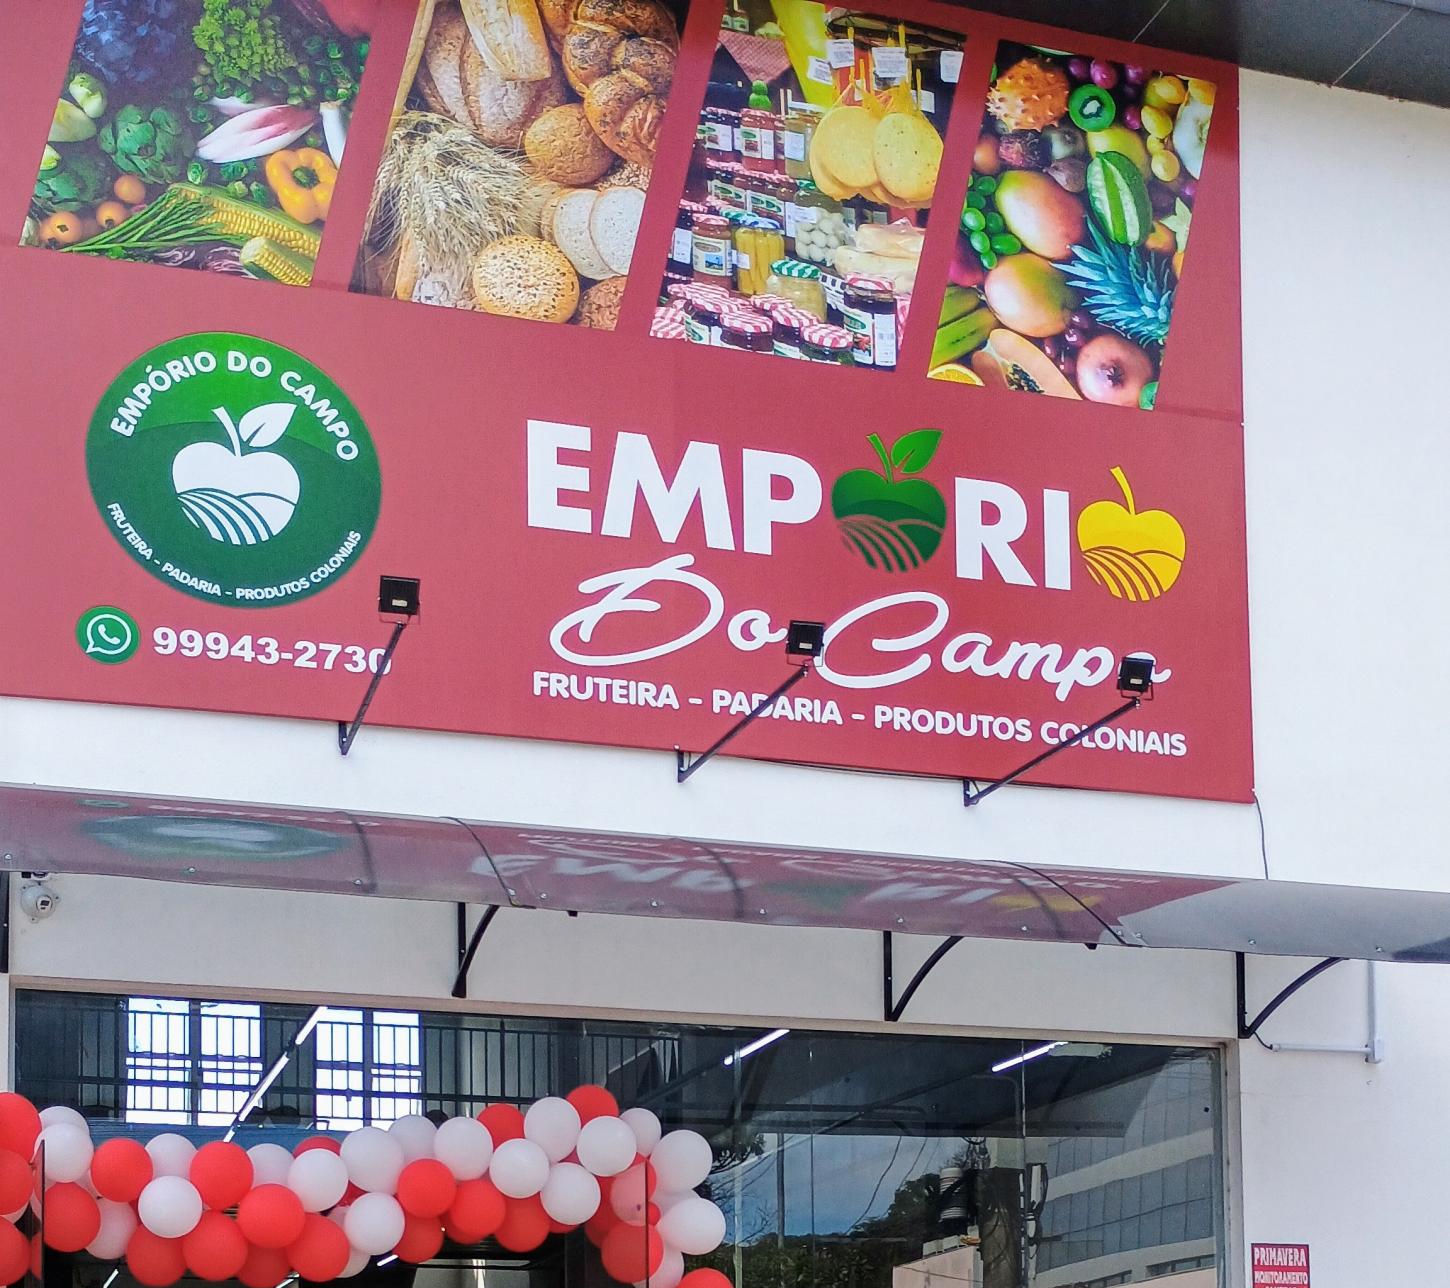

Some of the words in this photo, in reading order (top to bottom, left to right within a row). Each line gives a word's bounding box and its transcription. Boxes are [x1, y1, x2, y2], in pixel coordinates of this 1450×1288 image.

[110, 350, 217, 438] EMPÓRIO
[227, 350, 272, 378] DO
[279, 371, 359, 461] CAMPO
[107, 502, 154, 561] FRUTEIRA
[161, 562, 222, 597] PADARIA
[235, 577, 310, 601] PRODUTOS
[309, 530, 362, 584] COLONIAIS
[152, 625, 392, 675] 99943-2730
[549, 553, 789, 667] Do
[532, 670, 681, 710] FRUTEIRA
[711, 688, 844, 726] PADARIA
[873, 704, 1033, 743] PRODUTOS
[1039, 720, 1188, 757] COLONIAIS
[1253, 1247, 1307, 1267] PRIMAVERA
[1254, 1271, 1308, 1285] MONITORAMENTO
